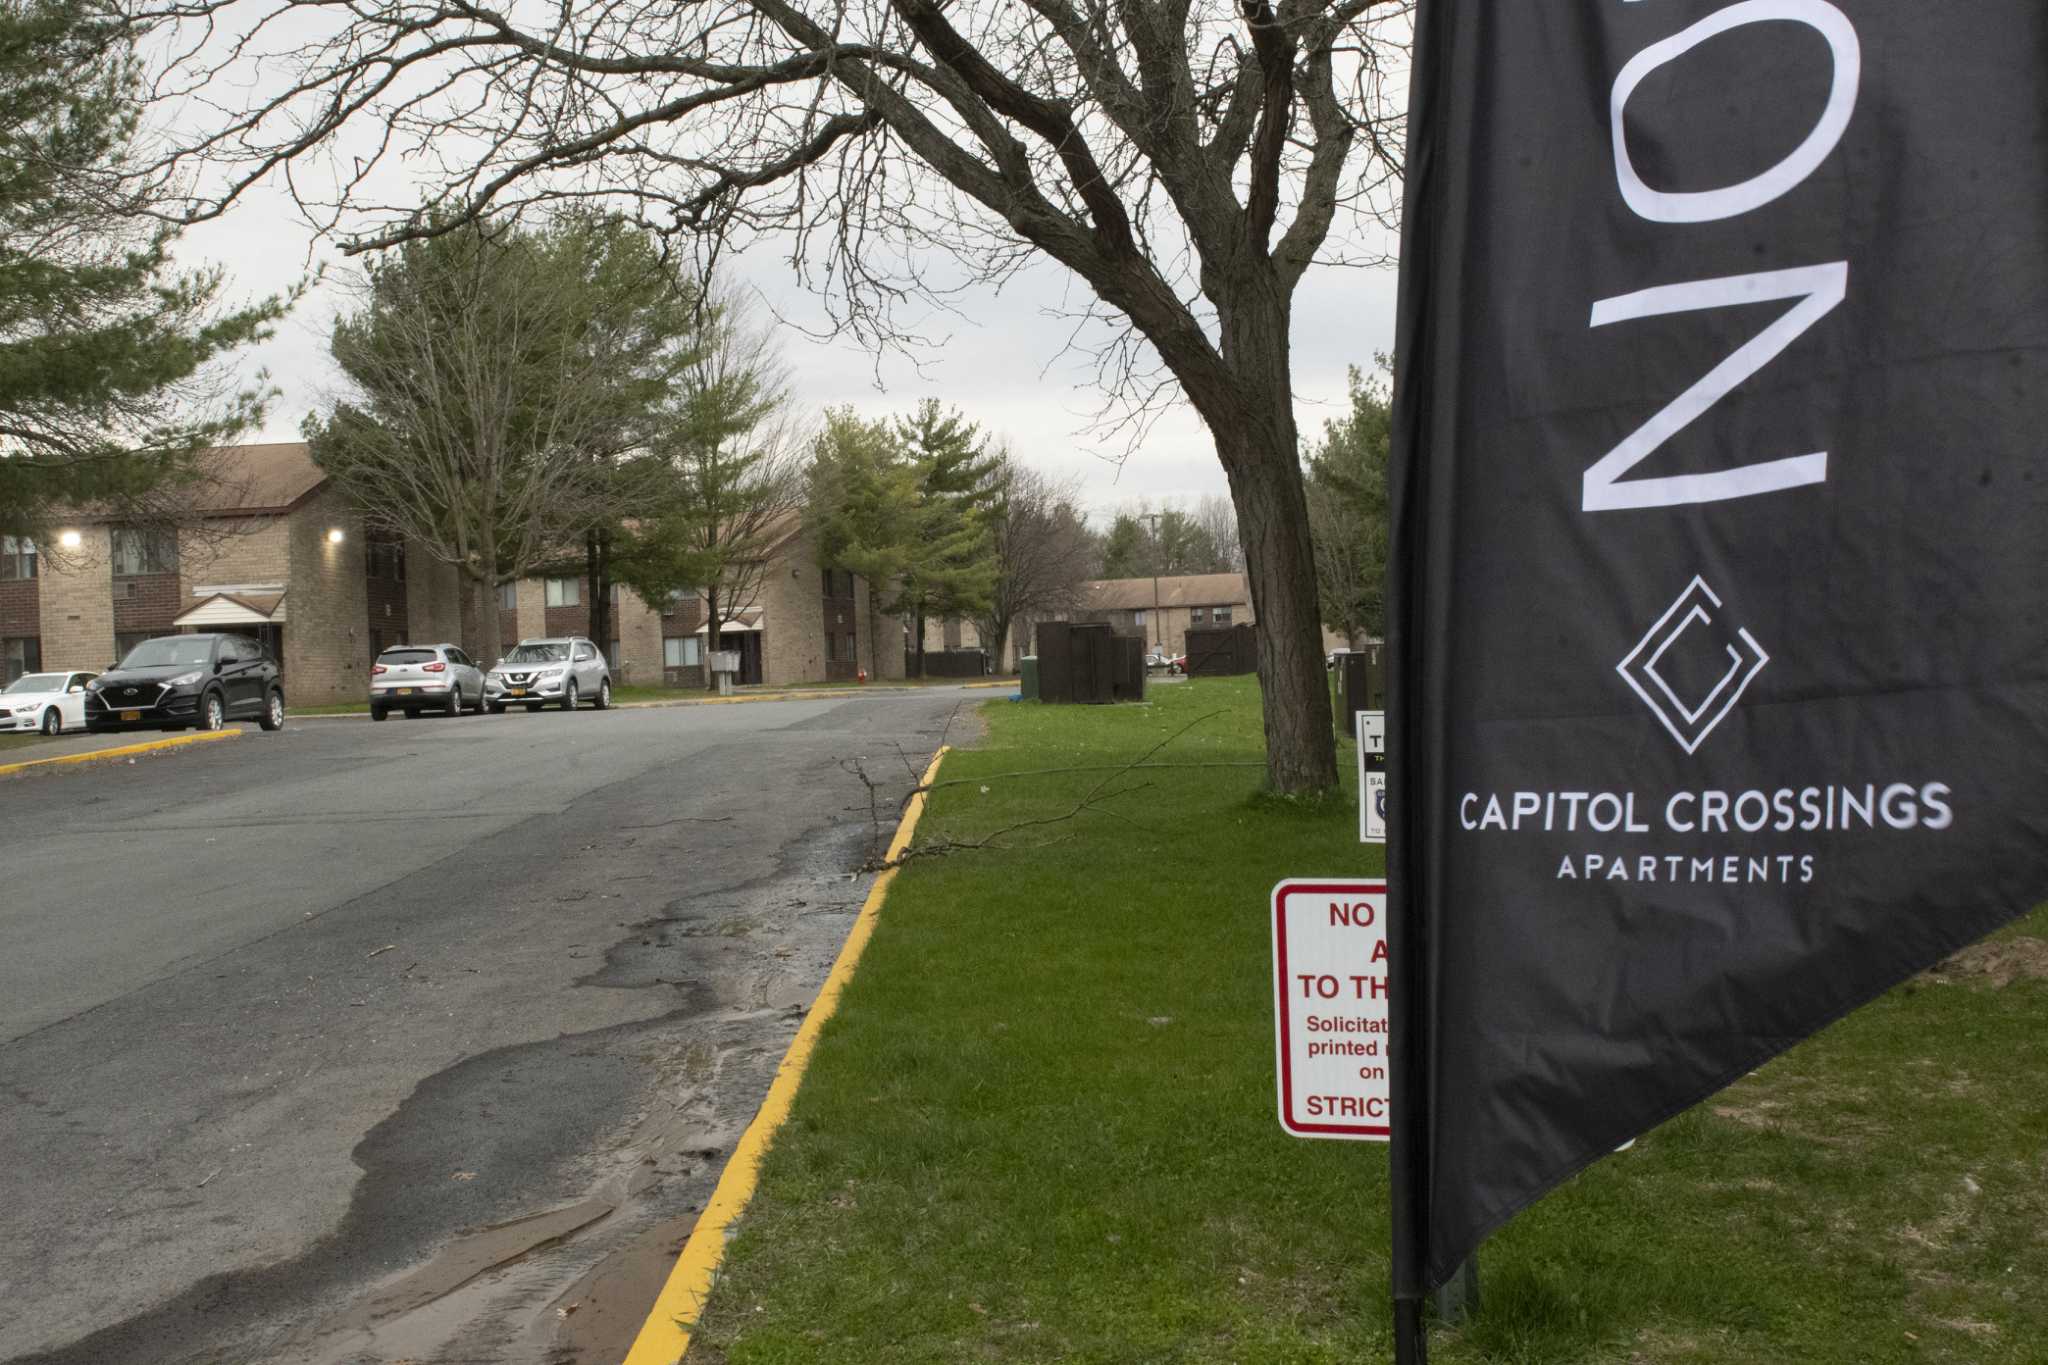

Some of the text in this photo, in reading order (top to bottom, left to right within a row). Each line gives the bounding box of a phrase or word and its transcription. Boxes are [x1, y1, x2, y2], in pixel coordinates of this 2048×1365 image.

[1460, 782, 1952, 833] CAPITOL CROSSINGS
[1557, 854, 1813, 883] APARTMENTS
[1329, 902, 1375, 927] NO
[1297, 974, 1339, 999] TO
[1306, 1015, 1388, 1033] Solicitat
[1308, 1039, 1378, 1058] printed
[1360, 1066, 1384, 1079] on
